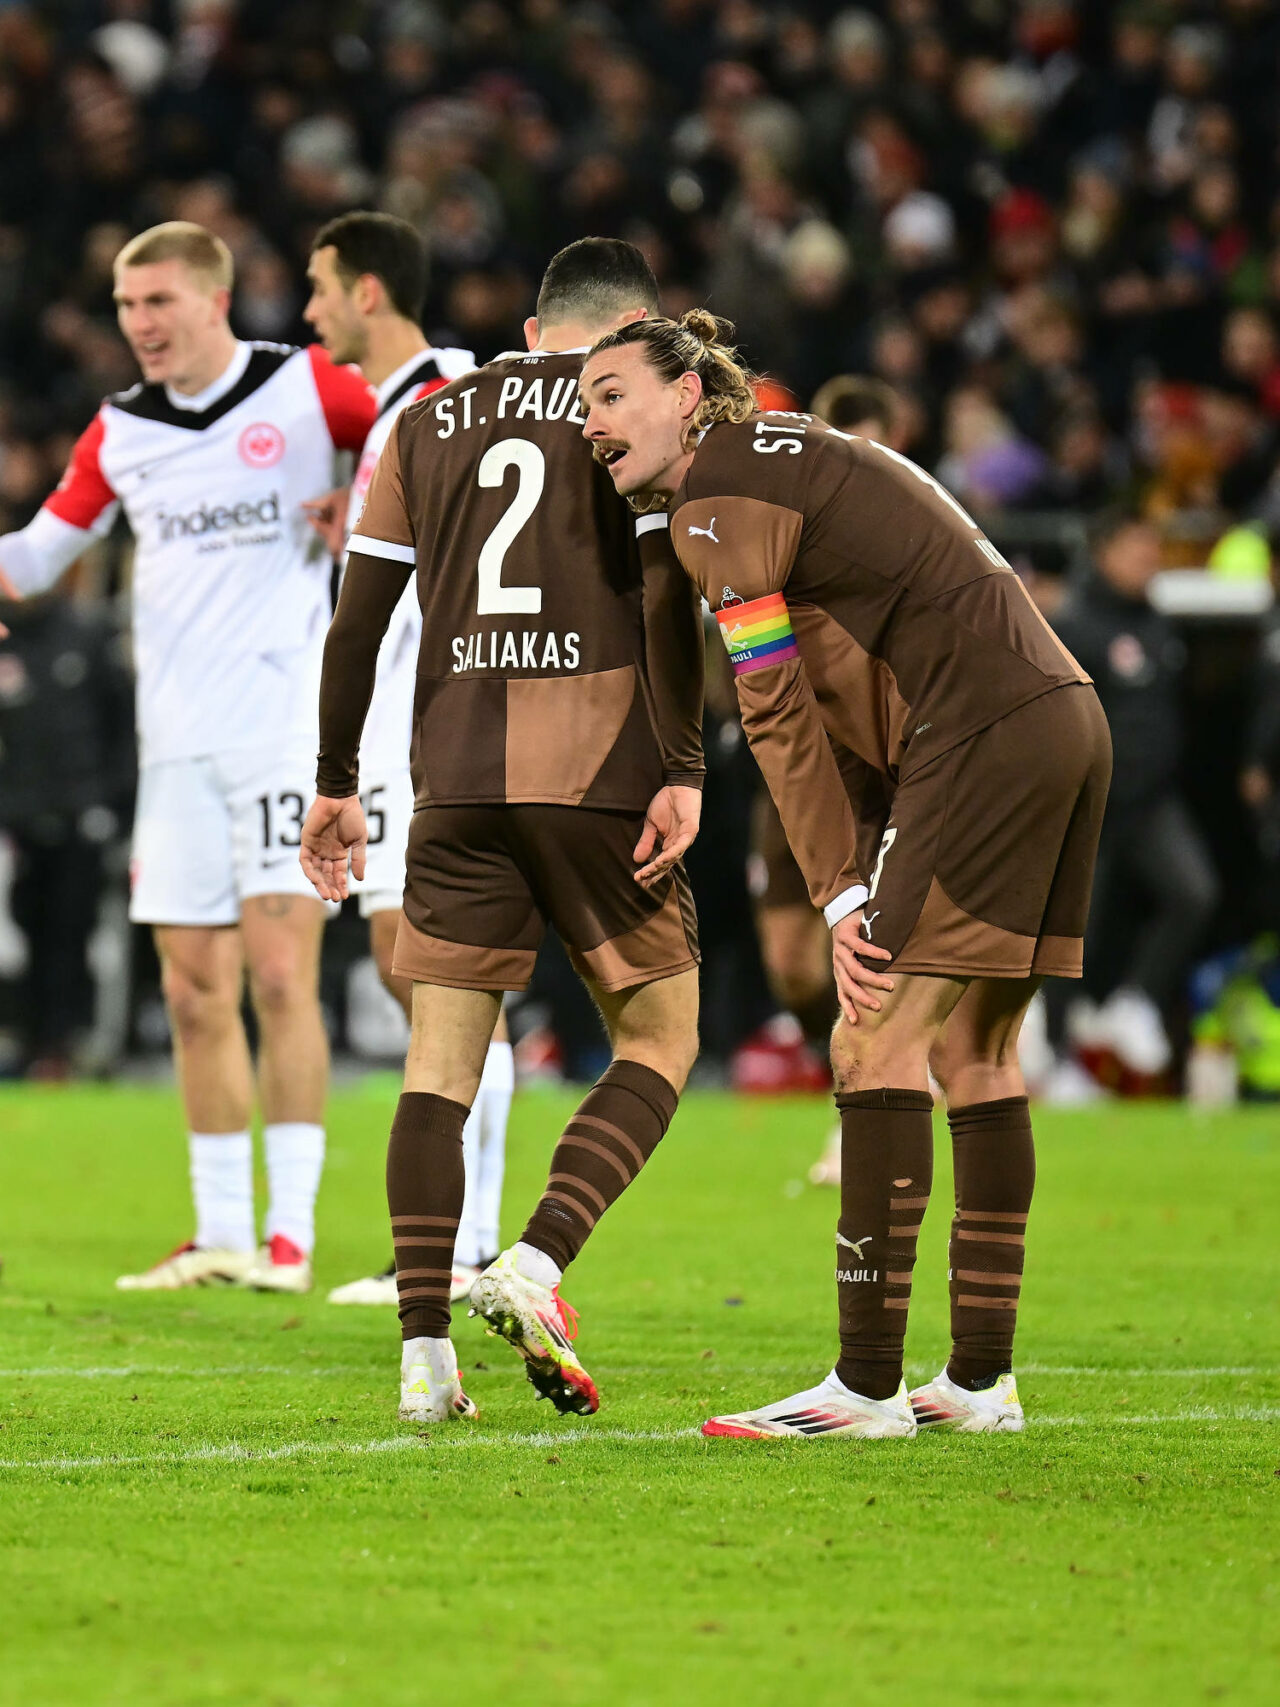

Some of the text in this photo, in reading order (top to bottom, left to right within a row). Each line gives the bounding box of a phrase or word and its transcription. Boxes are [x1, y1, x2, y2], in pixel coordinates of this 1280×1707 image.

[434, 376, 587, 440] ST. PAUL
[155, 490, 279, 542] indeed
[476, 437, 546, 616] 2
[451, 631, 581, 674] SALIAKAS
[258, 790, 305, 849] 13
